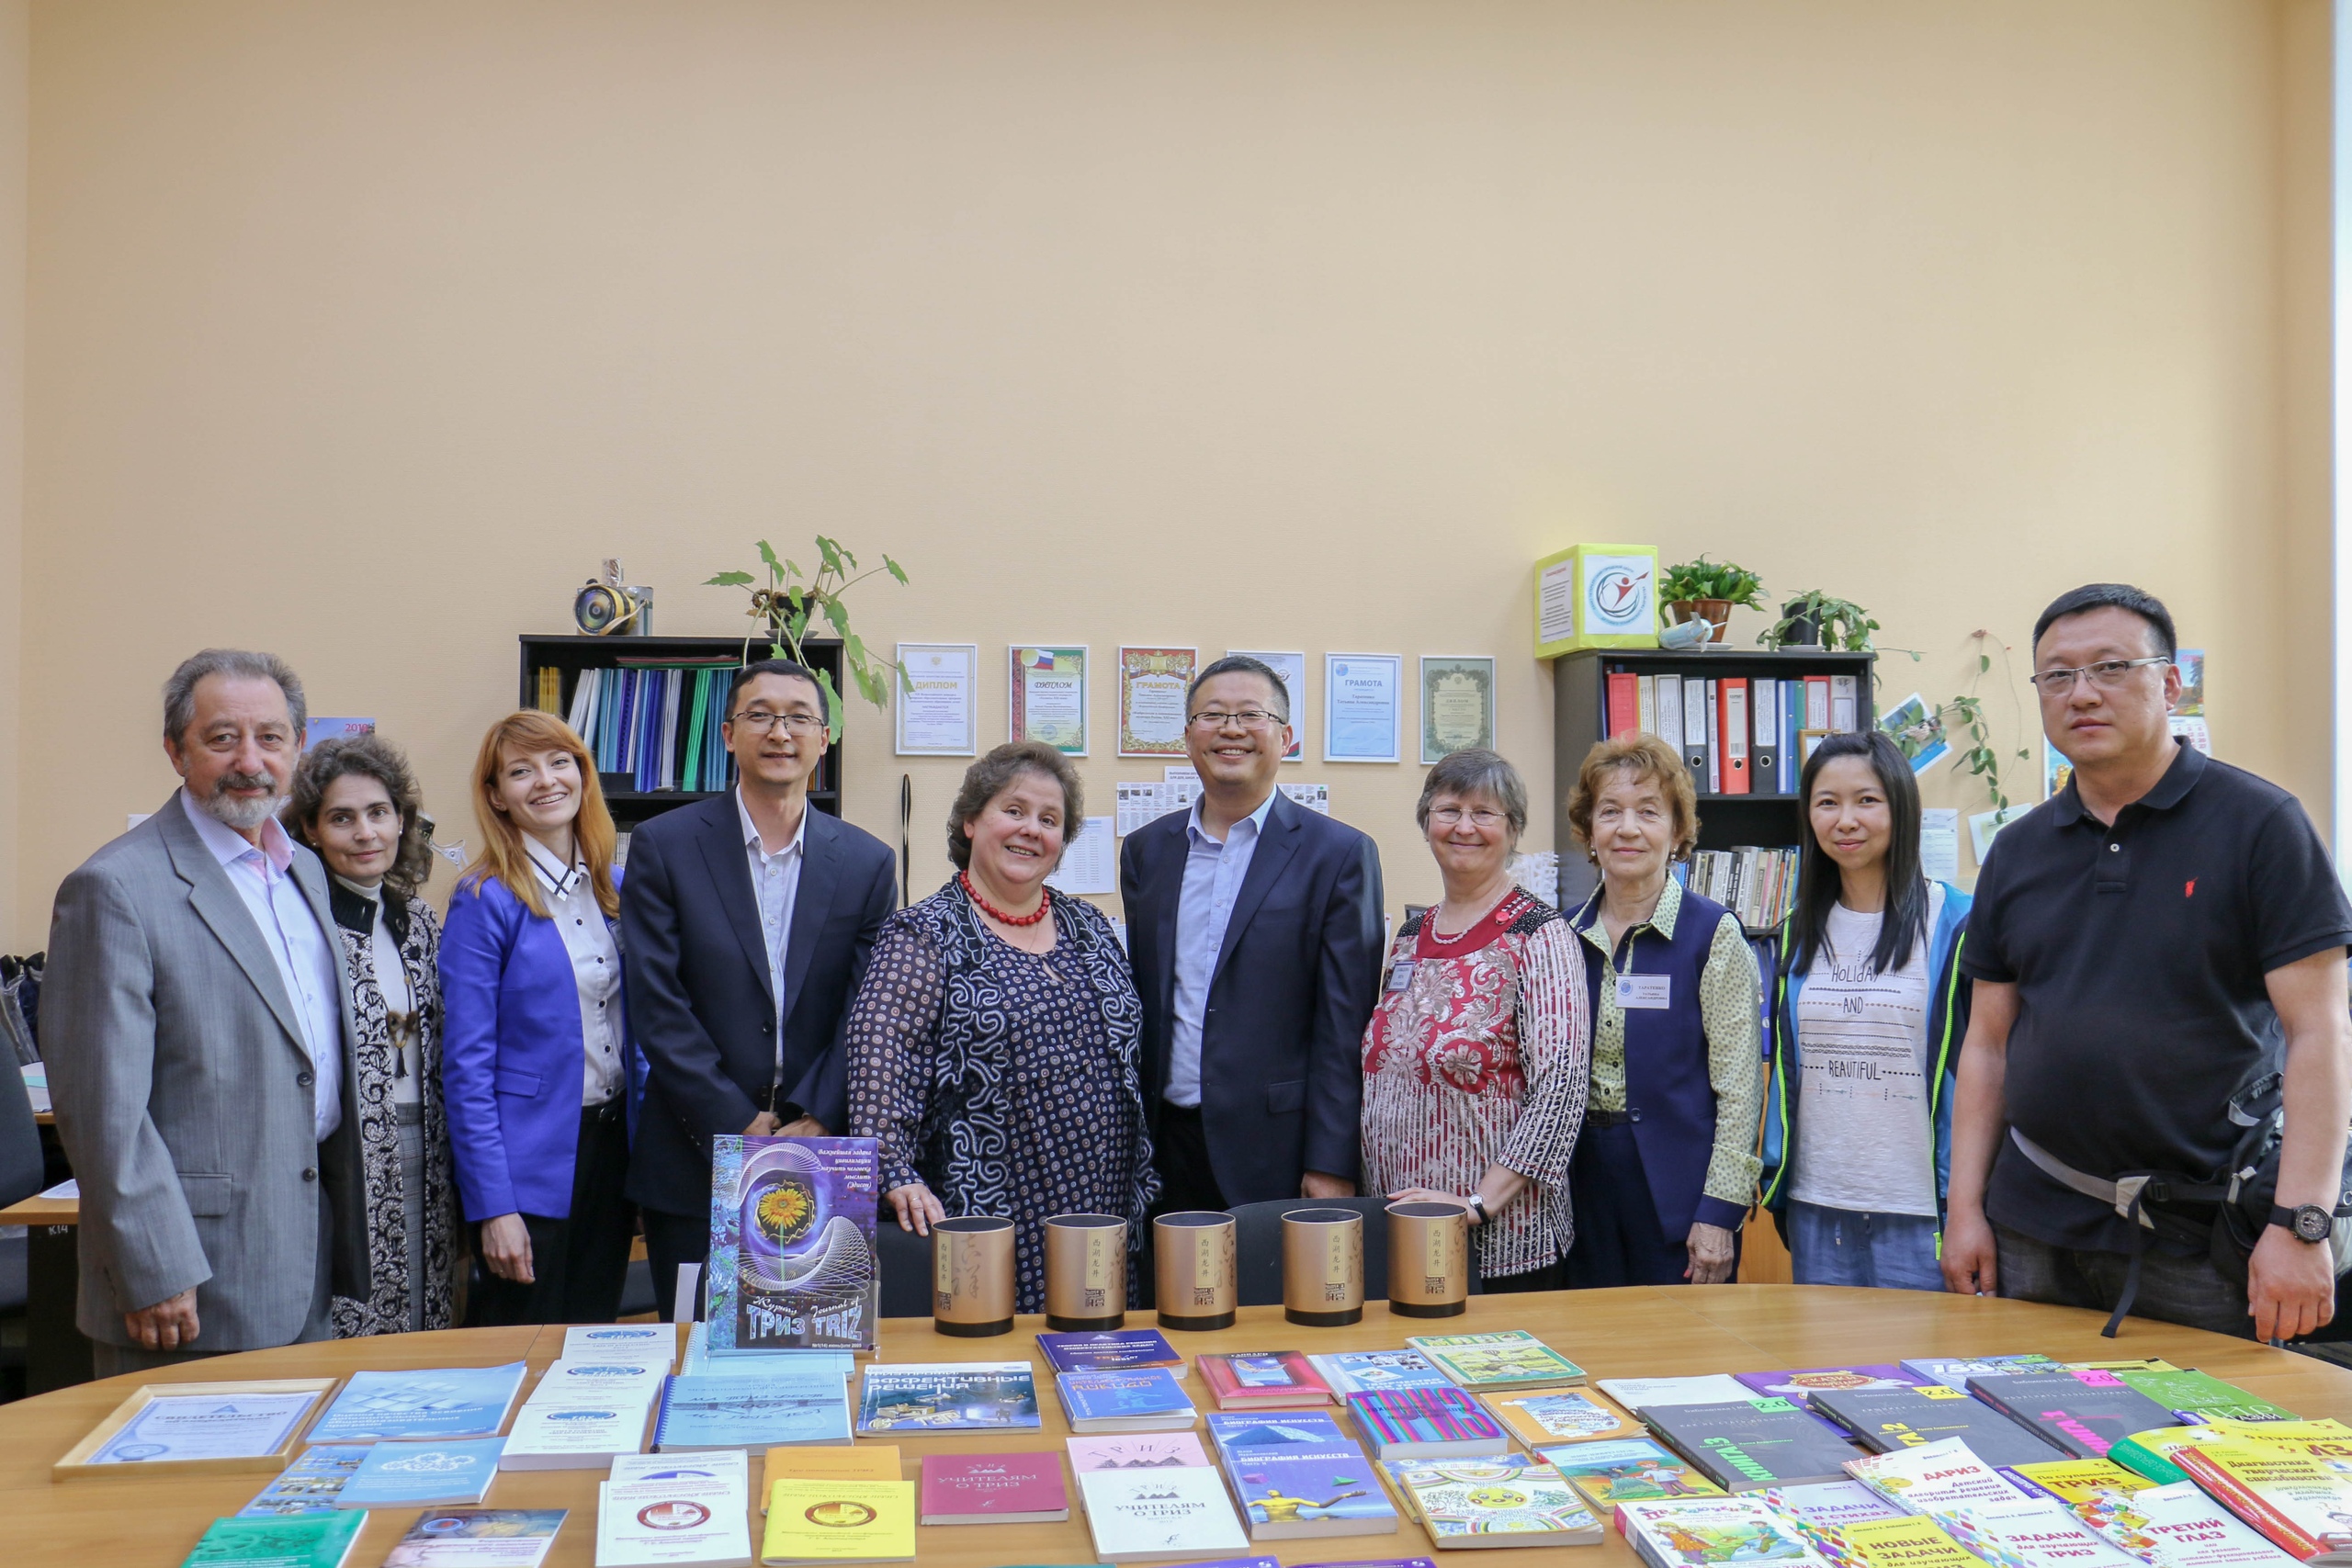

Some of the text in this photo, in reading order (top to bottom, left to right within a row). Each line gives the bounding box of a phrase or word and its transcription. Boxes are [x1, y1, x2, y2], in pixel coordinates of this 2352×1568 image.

[915, 681, 958, 690] ДИПЛОМ
[1034, 681, 1073, 690] ДИПЛОМ
[1136, 682, 1181, 690] ГРАМОТА
[1344, 679, 1383, 688] ГРАМОТА
[1843, 997, 1863, 1014] AND
[1828, 1060, 1882, 1080] BEAUTIFUL
[810, 1299, 847, 1318] Journal
[851, 1295, 859, 1307] of
[746, 1303, 863, 1341] ТРИЗ TRIZ
[1932, 1363, 1996, 1373] 150
[2081, 1374, 2113, 1382] 2.0
[1756, 1400, 1789, 1409] 2.0
[1348, 1387, 1501, 1445] ТРИЗ
[1088, 1444, 1181, 1459] ТРИЗ
[2226, 1459, 2312, 1468] Диагностика
[1922, 1465, 1981, 1481] ДАРИЗ
[2055, 1471, 2122, 1480] ступенькам
[2241, 1468, 2317, 1476] творческих
[938, 1474, 1037, 1483] УЧИТЕЛЯМ
[1951, 1476, 1994, 1489] Детский
[2047, 1478, 2122, 1490] ТРИЗ
[1129, 1483, 1178, 1493] ТРИЗ
[1907, 1483, 2002, 1499] алгоритм решения
[1917, 1488, 2009, 1504] изобретательских
[1989, 1494, 2018, 1503] задач
[1114, 1502, 1206, 1511] УЧИТЕЛЯМ
[1803, 1502, 1882, 1513] ЗАДАЧИ
[1831, 1509, 1892, 1519] стихах
[2146, 1517, 2226, 1535] ТРЕТИЙ
[2005, 1530, 2086, 1542] ЗАДАЧИ
[2173, 1531, 2227, 1543] ГЛАЗ
[1869, 1536, 1943, 1550] НОВЫЕ
[2039, 1540, 2099, 1550] изучающих
[1877, 1546, 1959, 1560] ЗАДАЧИ
[2042, 1549, 2096, 1559] ТРИЗ
[1910, 1555, 1972, 1566] изучающих
